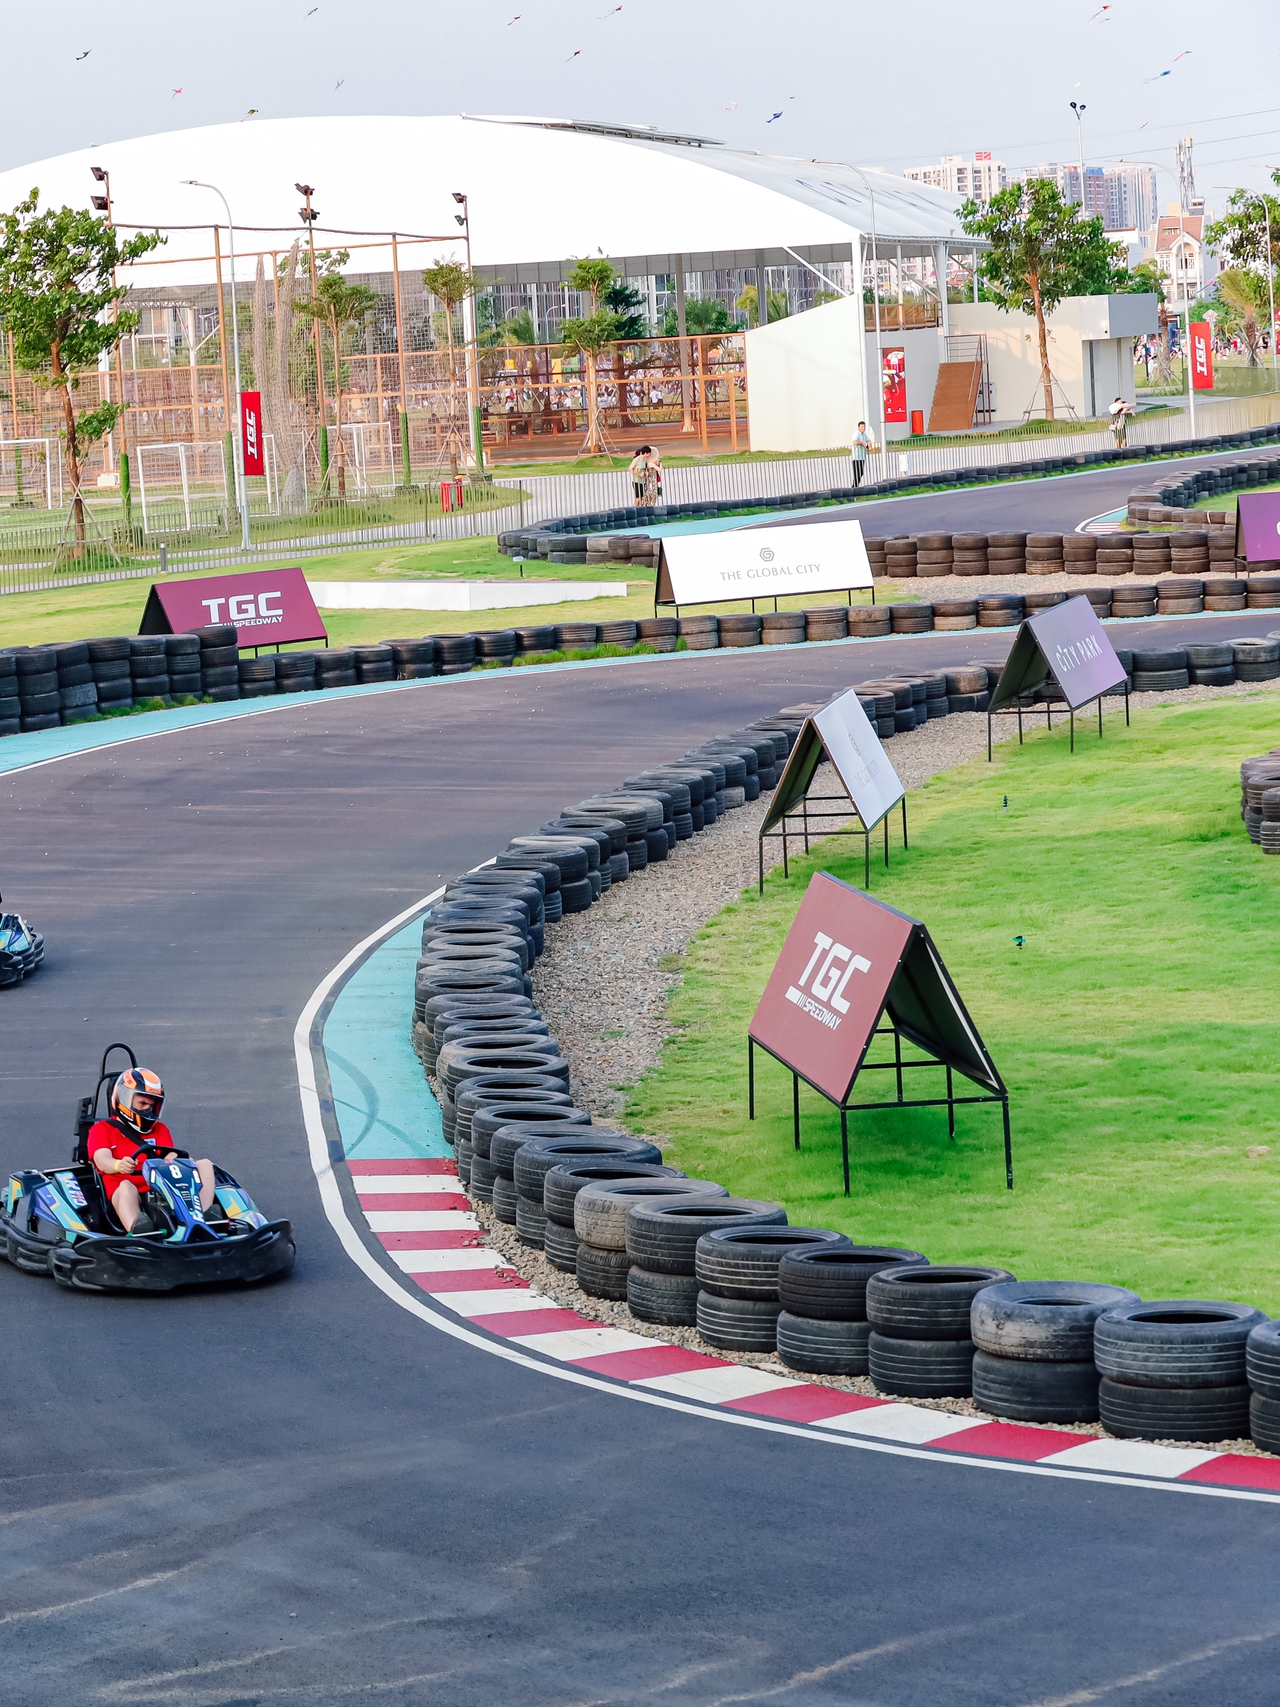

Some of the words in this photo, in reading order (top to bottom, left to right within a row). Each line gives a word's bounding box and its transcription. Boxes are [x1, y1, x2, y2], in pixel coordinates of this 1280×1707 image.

[1195, 335, 1206, 374] TGC
[245, 408, 256, 456] TGC
[720, 570, 743, 581] THE
[746, 566, 793, 579] GLOBAL
[796, 563, 821, 575] CITY
[201, 590, 284, 624] TGC
[233, 615, 283, 628] SPEEDWAY
[1076, 634, 1103, 662] PARK
[797, 930, 873, 1015] TGC
[802, 997, 842, 1031] SPEEDWAY
[168, 1164, 183, 1179] 8
